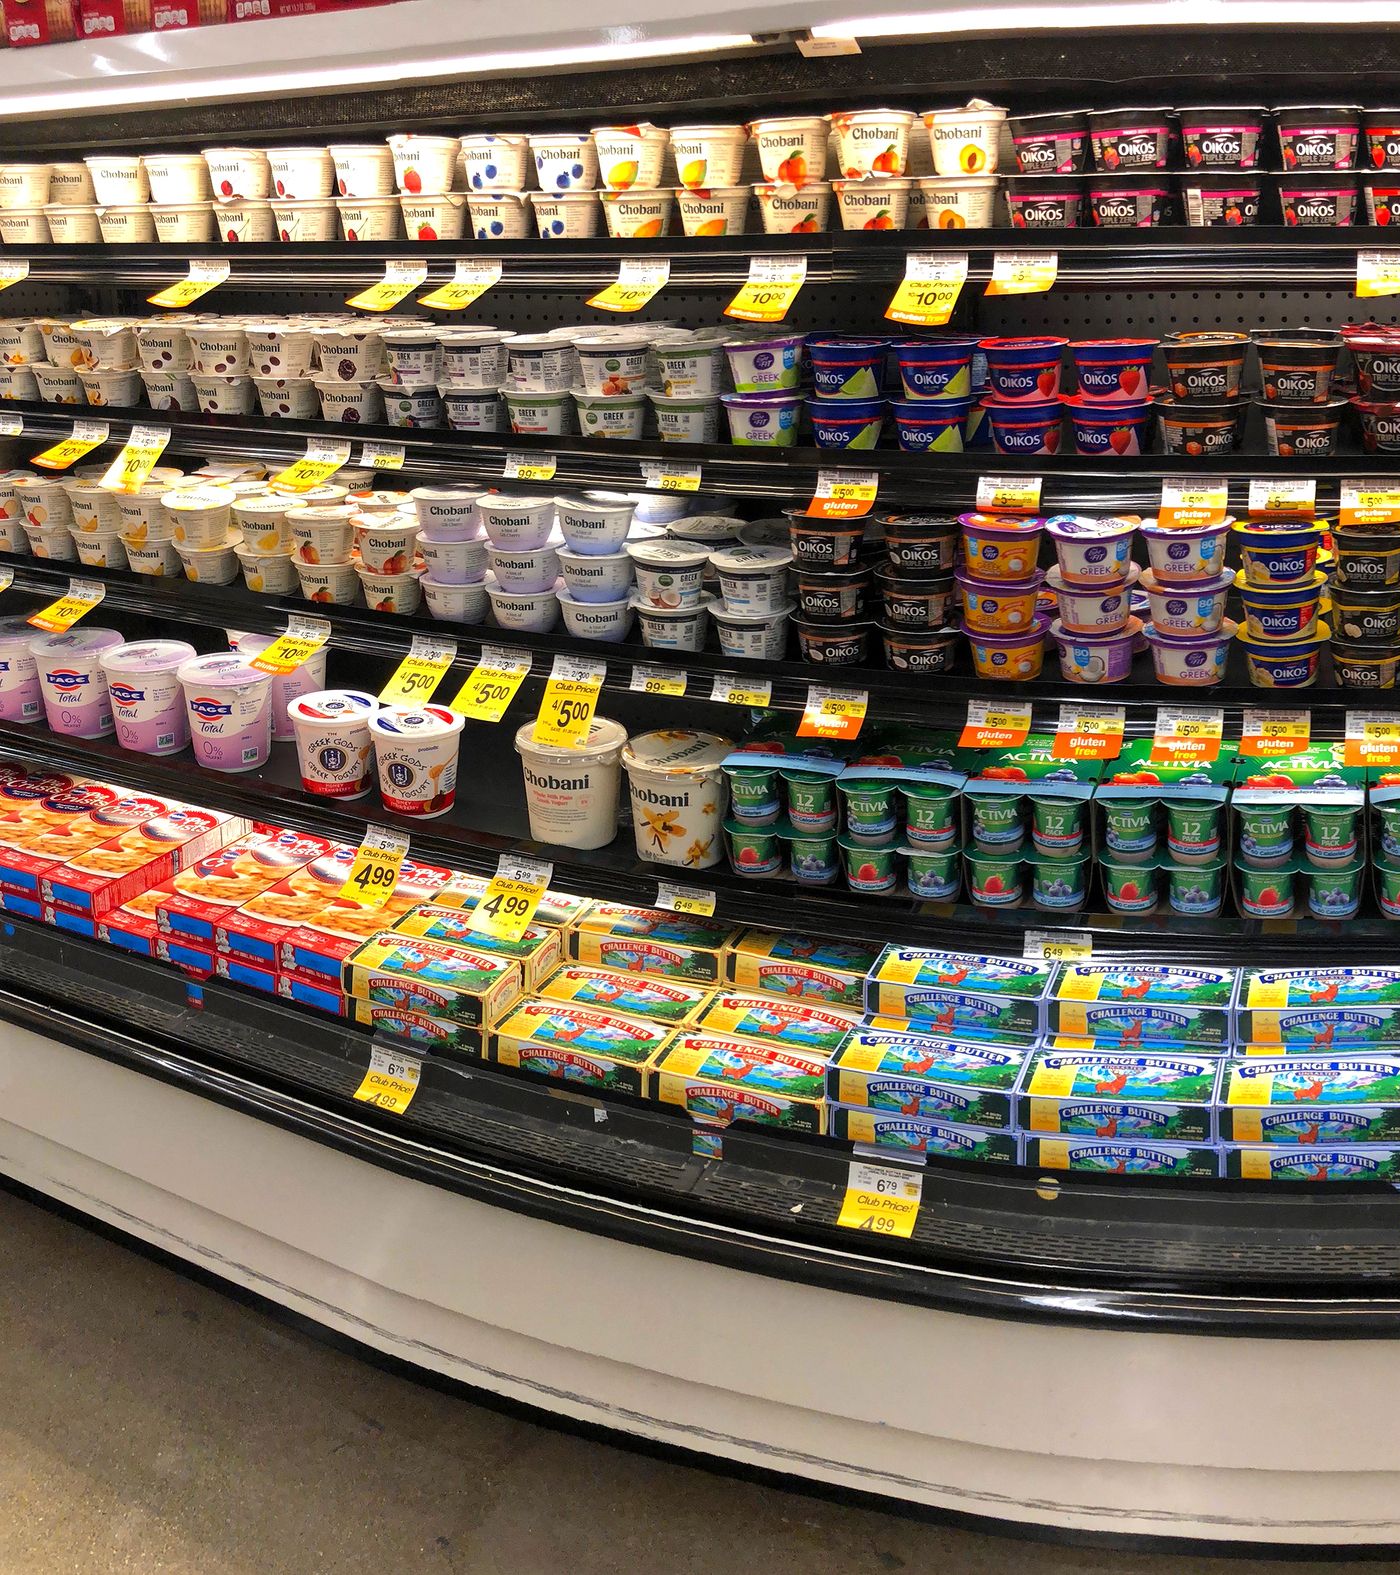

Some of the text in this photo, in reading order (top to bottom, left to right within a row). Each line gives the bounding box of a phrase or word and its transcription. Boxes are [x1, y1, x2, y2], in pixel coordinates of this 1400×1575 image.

[852, 127, 898, 140] Chobani
[934, 127, 981, 140] Chobani
[541, 148, 580, 159] Chobani
[1118, 142, 1155, 156] OIKOS
[1296, 142, 1332, 155] OIKOS
[101, 169, 138, 179] Chobani
[844, 194, 890, 206] Chobani
[619, 204, 661, 214] Chobani
[140, 338, 172, 348] Chobani
[200, 343, 237, 351] Chobani
[322, 345, 358, 354] Chobani
[667, 360, 686, 370] GREEK
[752, 374, 780, 384] GREEK
[914, 373, 949, 385] OIKOS
[1000, 376, 1033, 388] OIKOS
[1084, 373, 1117, 385] OIKOS
[430, 504, 472, 515] Chobani
[823, 502, 858, 511] gluten
[489, 516, 530, 526] Chobani
[902, 549, 938, 561] OIKOS
[1080, 566, 1111, 576] GREEK
[1164, 562, 1196, 572] GREEK
[1269, 560, 1305, 572] OIKOS
[575, 612, 618, 623] Chobani
[481, 669, 502, 678] Club
[556, 682, 572, 692] Club
[56, 692, 82, 703] Total
[199, 721, 224, 734] Total
[977, 731, 1012, 741] gluten
[981, 738, 1003, 746] free
[1069, 738, 1106, 748] gluten
[1075, 746, 1098, 756] free
[1360, 743, 1398, 754] gluten
[1367, 753, 1390, 762] free
[1261, 759, 1342, 770] ACTIVIA
[524, 765, 589, 790] Chobani
[848, 800, 889, 812] ACTIVIA
[917, 809, 935, 824] 12
[974, 808, 1018, 820] ACTIVIA
[915, 822, 934, 830] PACK
[1244, 821, 1289, 834] ACTIVIA
[1321, 826, 1340, 839] 12
[1321, 839, 1340, 847] PACK
[362, 849, 379, 859] Club
[495, 879, 512, 889] Club
[381, 937, 496, 969] CHALLENGE BUTTER
[902, 952, 1038, 974] CHALLENGE BUTTER
[1263, 969, 1338, 981] CHALLENGE
[529, 1006, 653, 1040] CHALLENGE BUTTER
[521, 1048, 604, 1078] CHALLENGE BUTTER
[1244, 1062, 1398, 1076] CHALLENGE BUTTER
[870, 1081, 967, 1108] CHALLENGE BUTTER
[1062, 1104, 1166, 1123] CHALLENGE BUTTER
[1265, 1111, 1368, 1127] CHALLENGE BUTTER
[1069, 1148, 1174, 1166] CHALLENGE BUTTER
[857, 1195, 913, 1212] Club Price!
